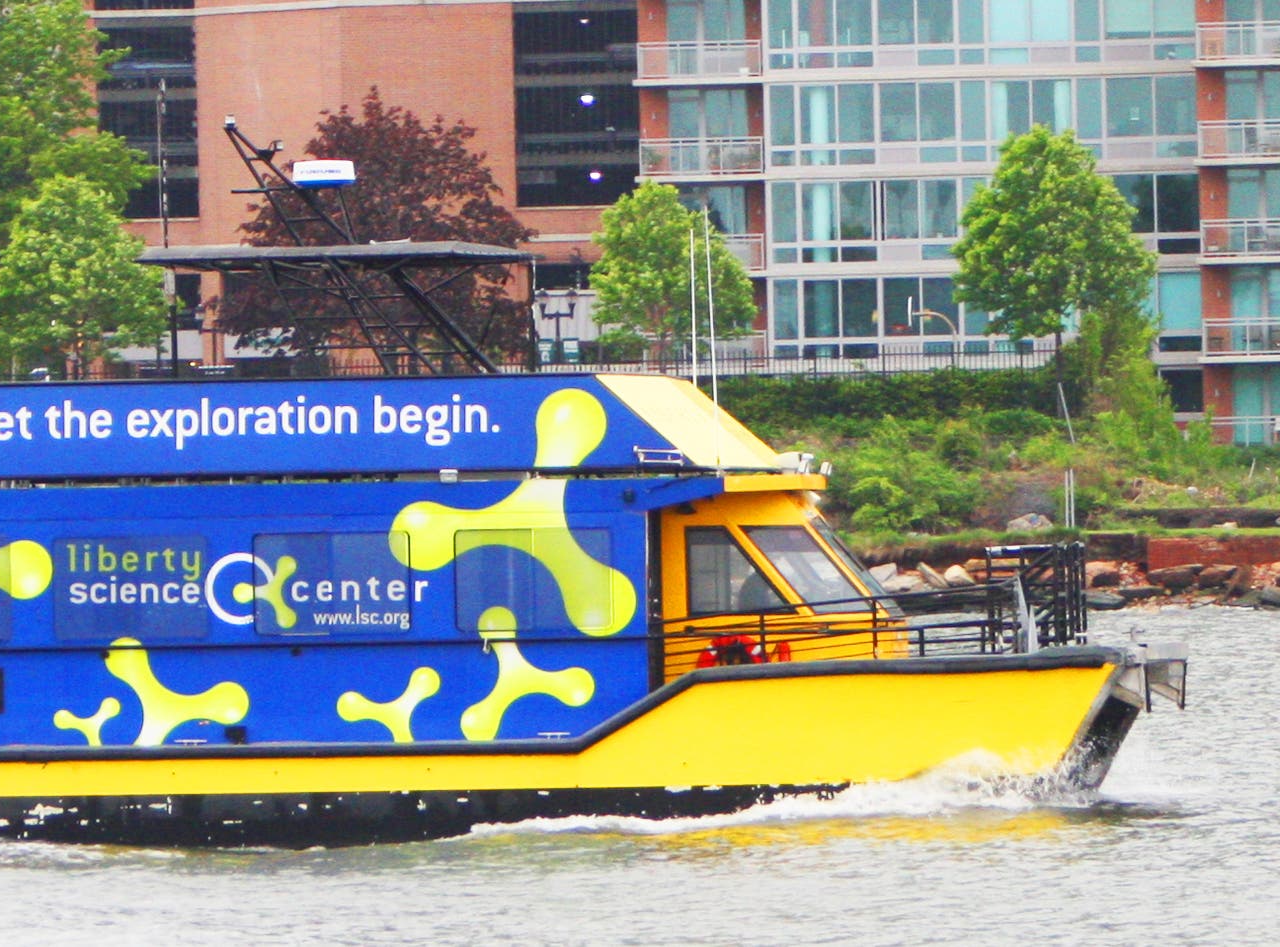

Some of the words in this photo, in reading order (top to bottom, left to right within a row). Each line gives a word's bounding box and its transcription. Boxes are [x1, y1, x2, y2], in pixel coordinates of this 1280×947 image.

[44, 400, 113, 439] the
[126, 395, 358, 450] exploration
[373, 394, 501, 446] begin.
[66, 544, 201, 581] liberty
[69, 576, 200, 604] science
[290, 578, 429, 603] center
[313, 605, 411, 630] www.lsc.org
